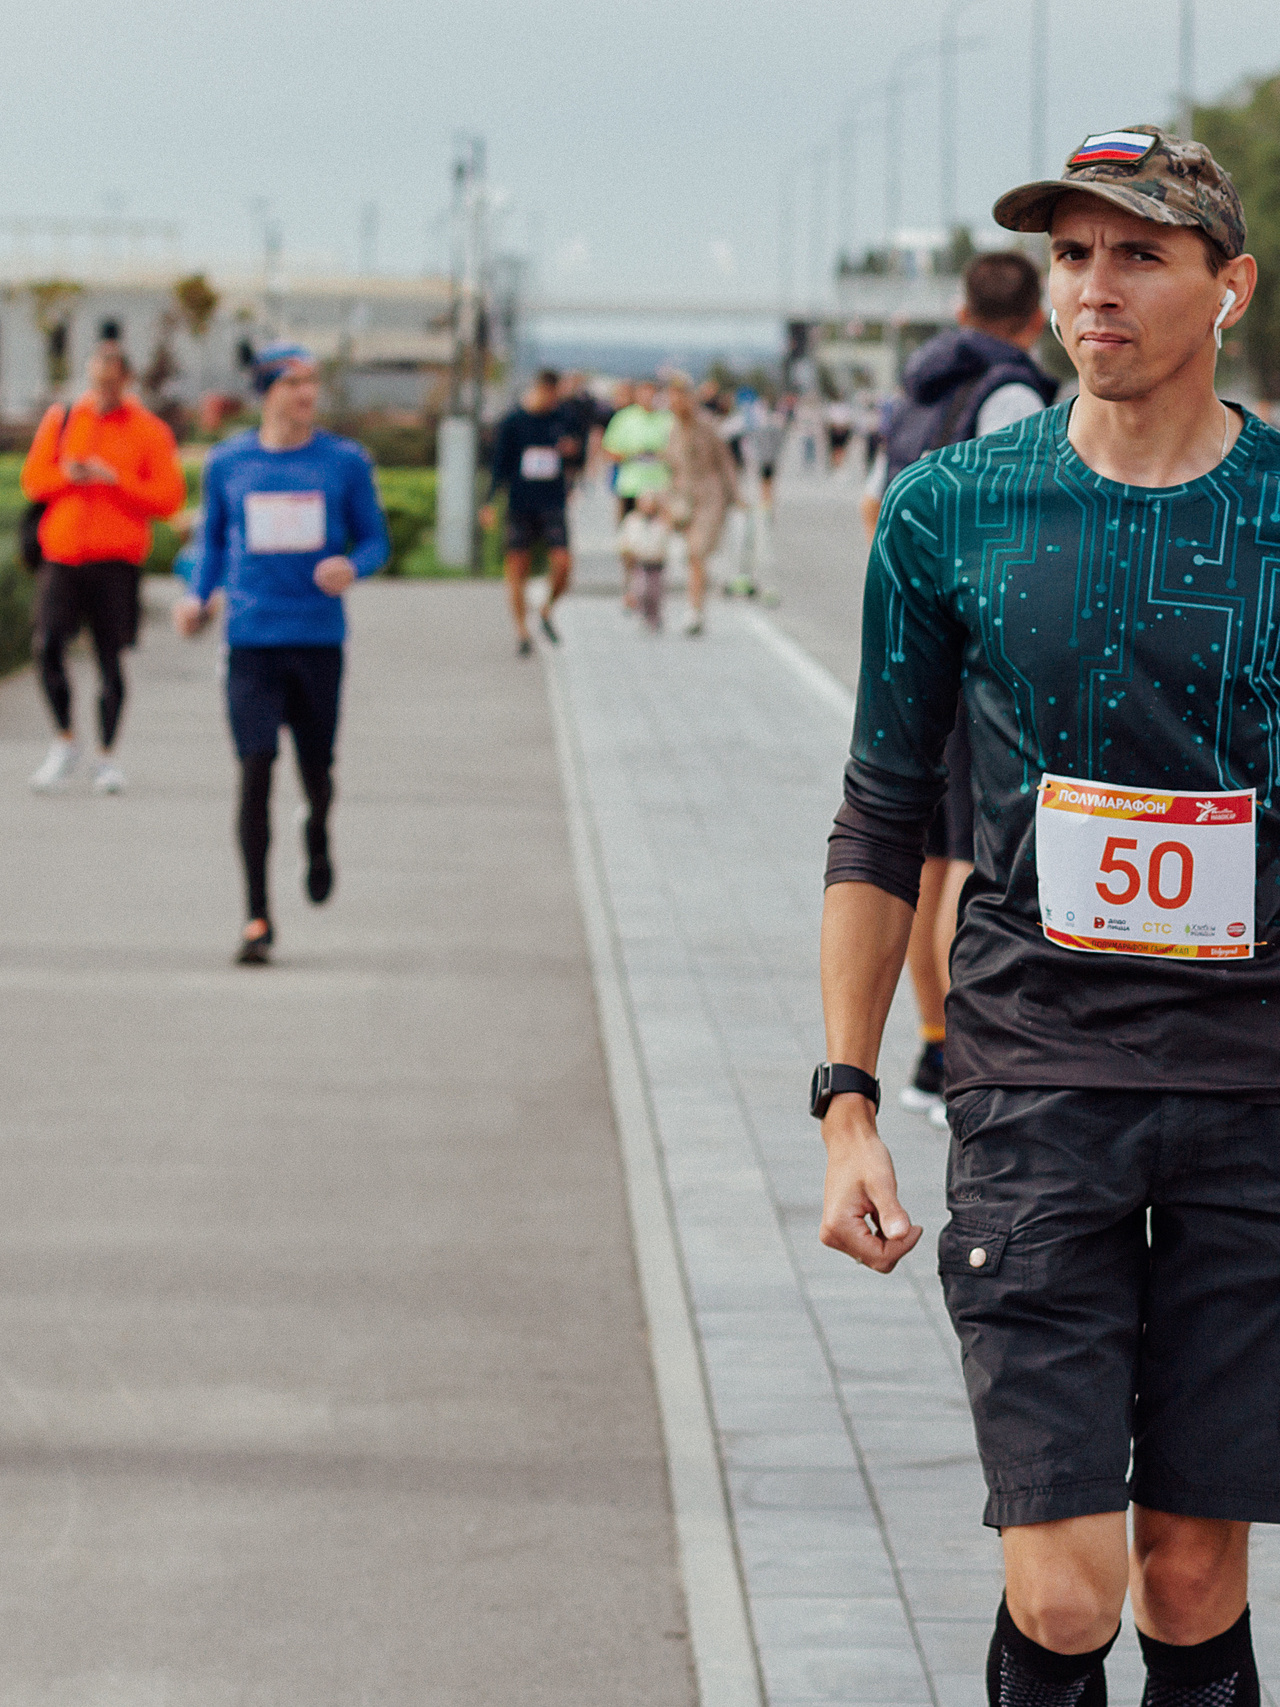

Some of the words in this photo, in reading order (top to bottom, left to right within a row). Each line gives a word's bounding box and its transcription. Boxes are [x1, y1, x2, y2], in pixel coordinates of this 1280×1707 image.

[1058, 789, 1167, 815] ПОЛУМАРАФОН
[1095, 836, 1194, 910] 50
[1091, 940, 1149, 951] ПОЛУМАРАФОН
